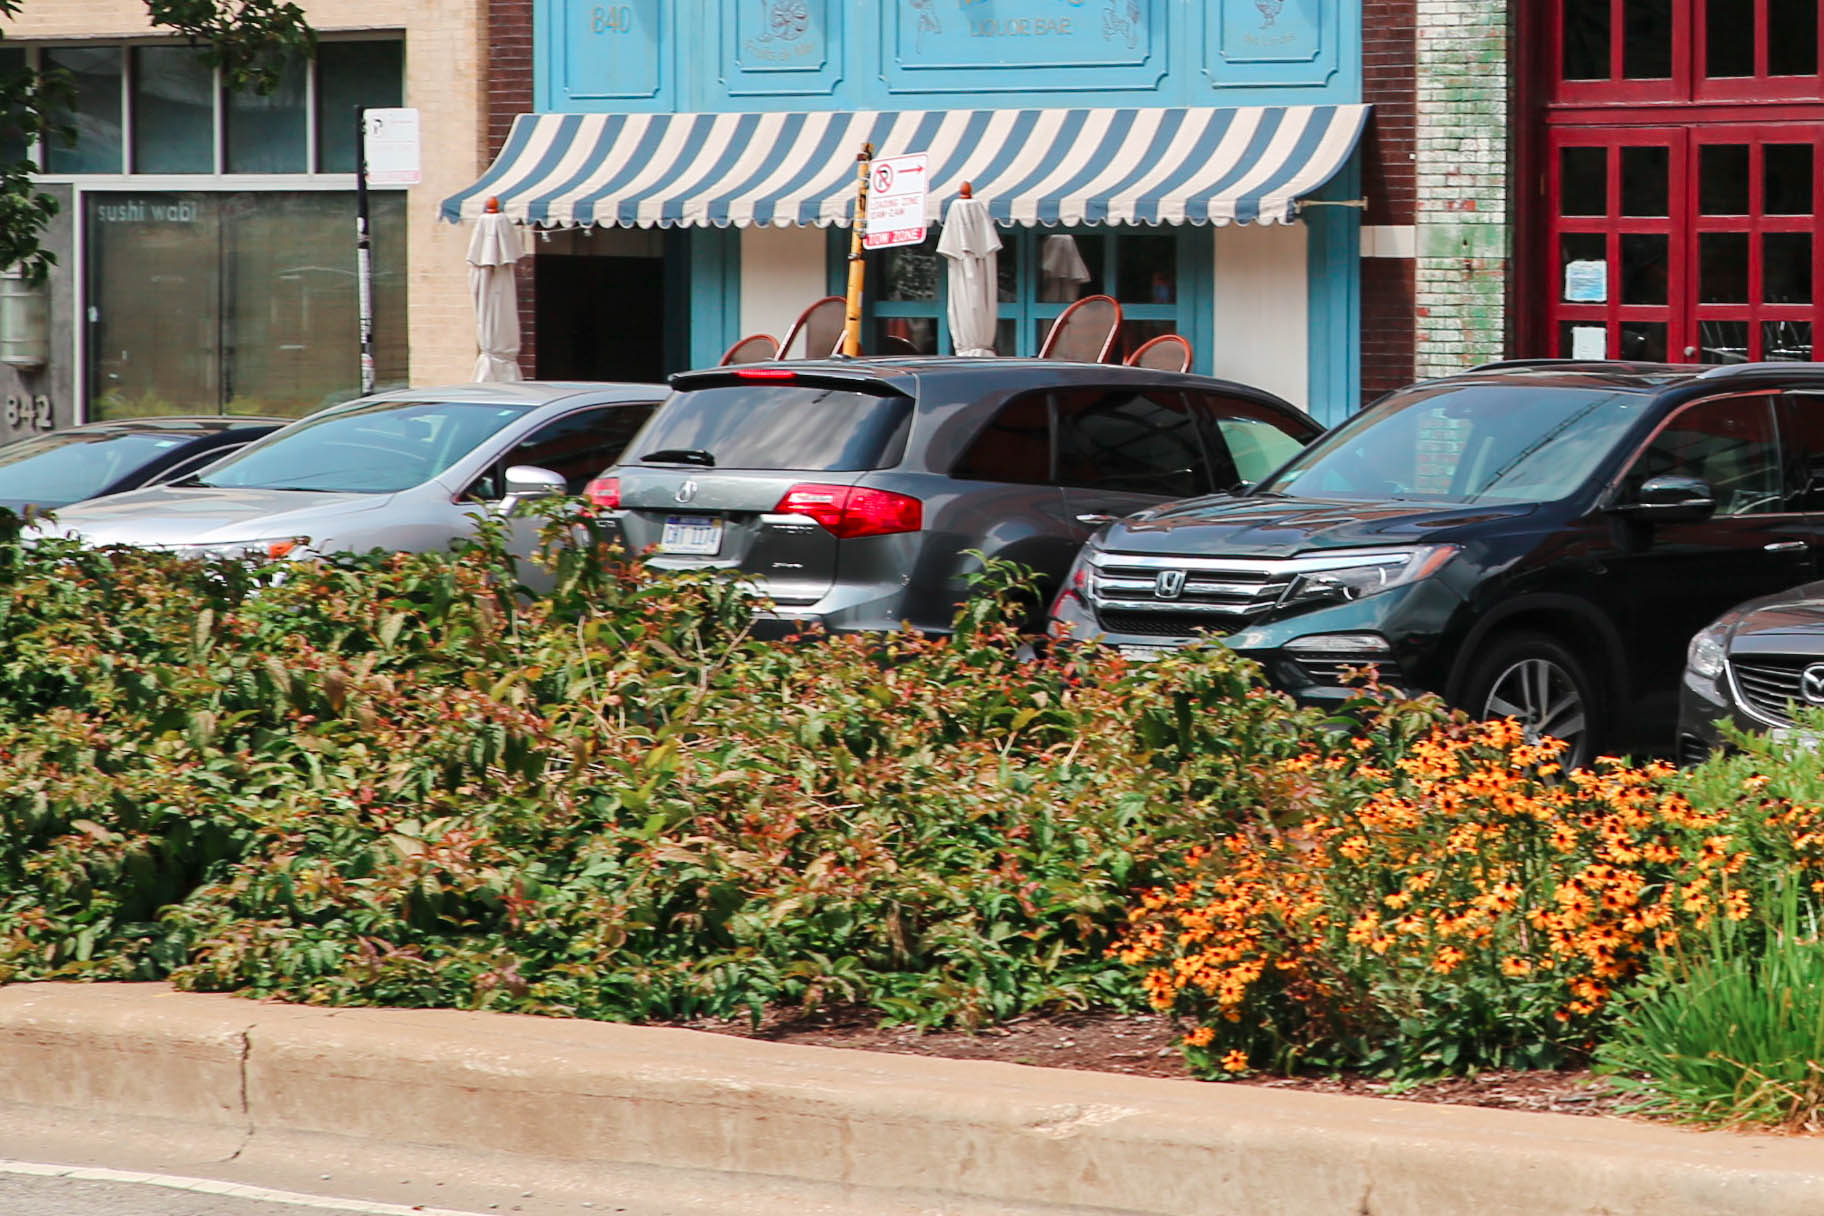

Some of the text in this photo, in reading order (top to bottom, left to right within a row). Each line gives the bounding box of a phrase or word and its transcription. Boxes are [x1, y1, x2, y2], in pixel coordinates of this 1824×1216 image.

[591, 4, 631, 34] 840
[98, 200, 196, 222] sushi wabi
[893, 229, 920, 241] ZONE
[5, 394, 52, 432] 842
